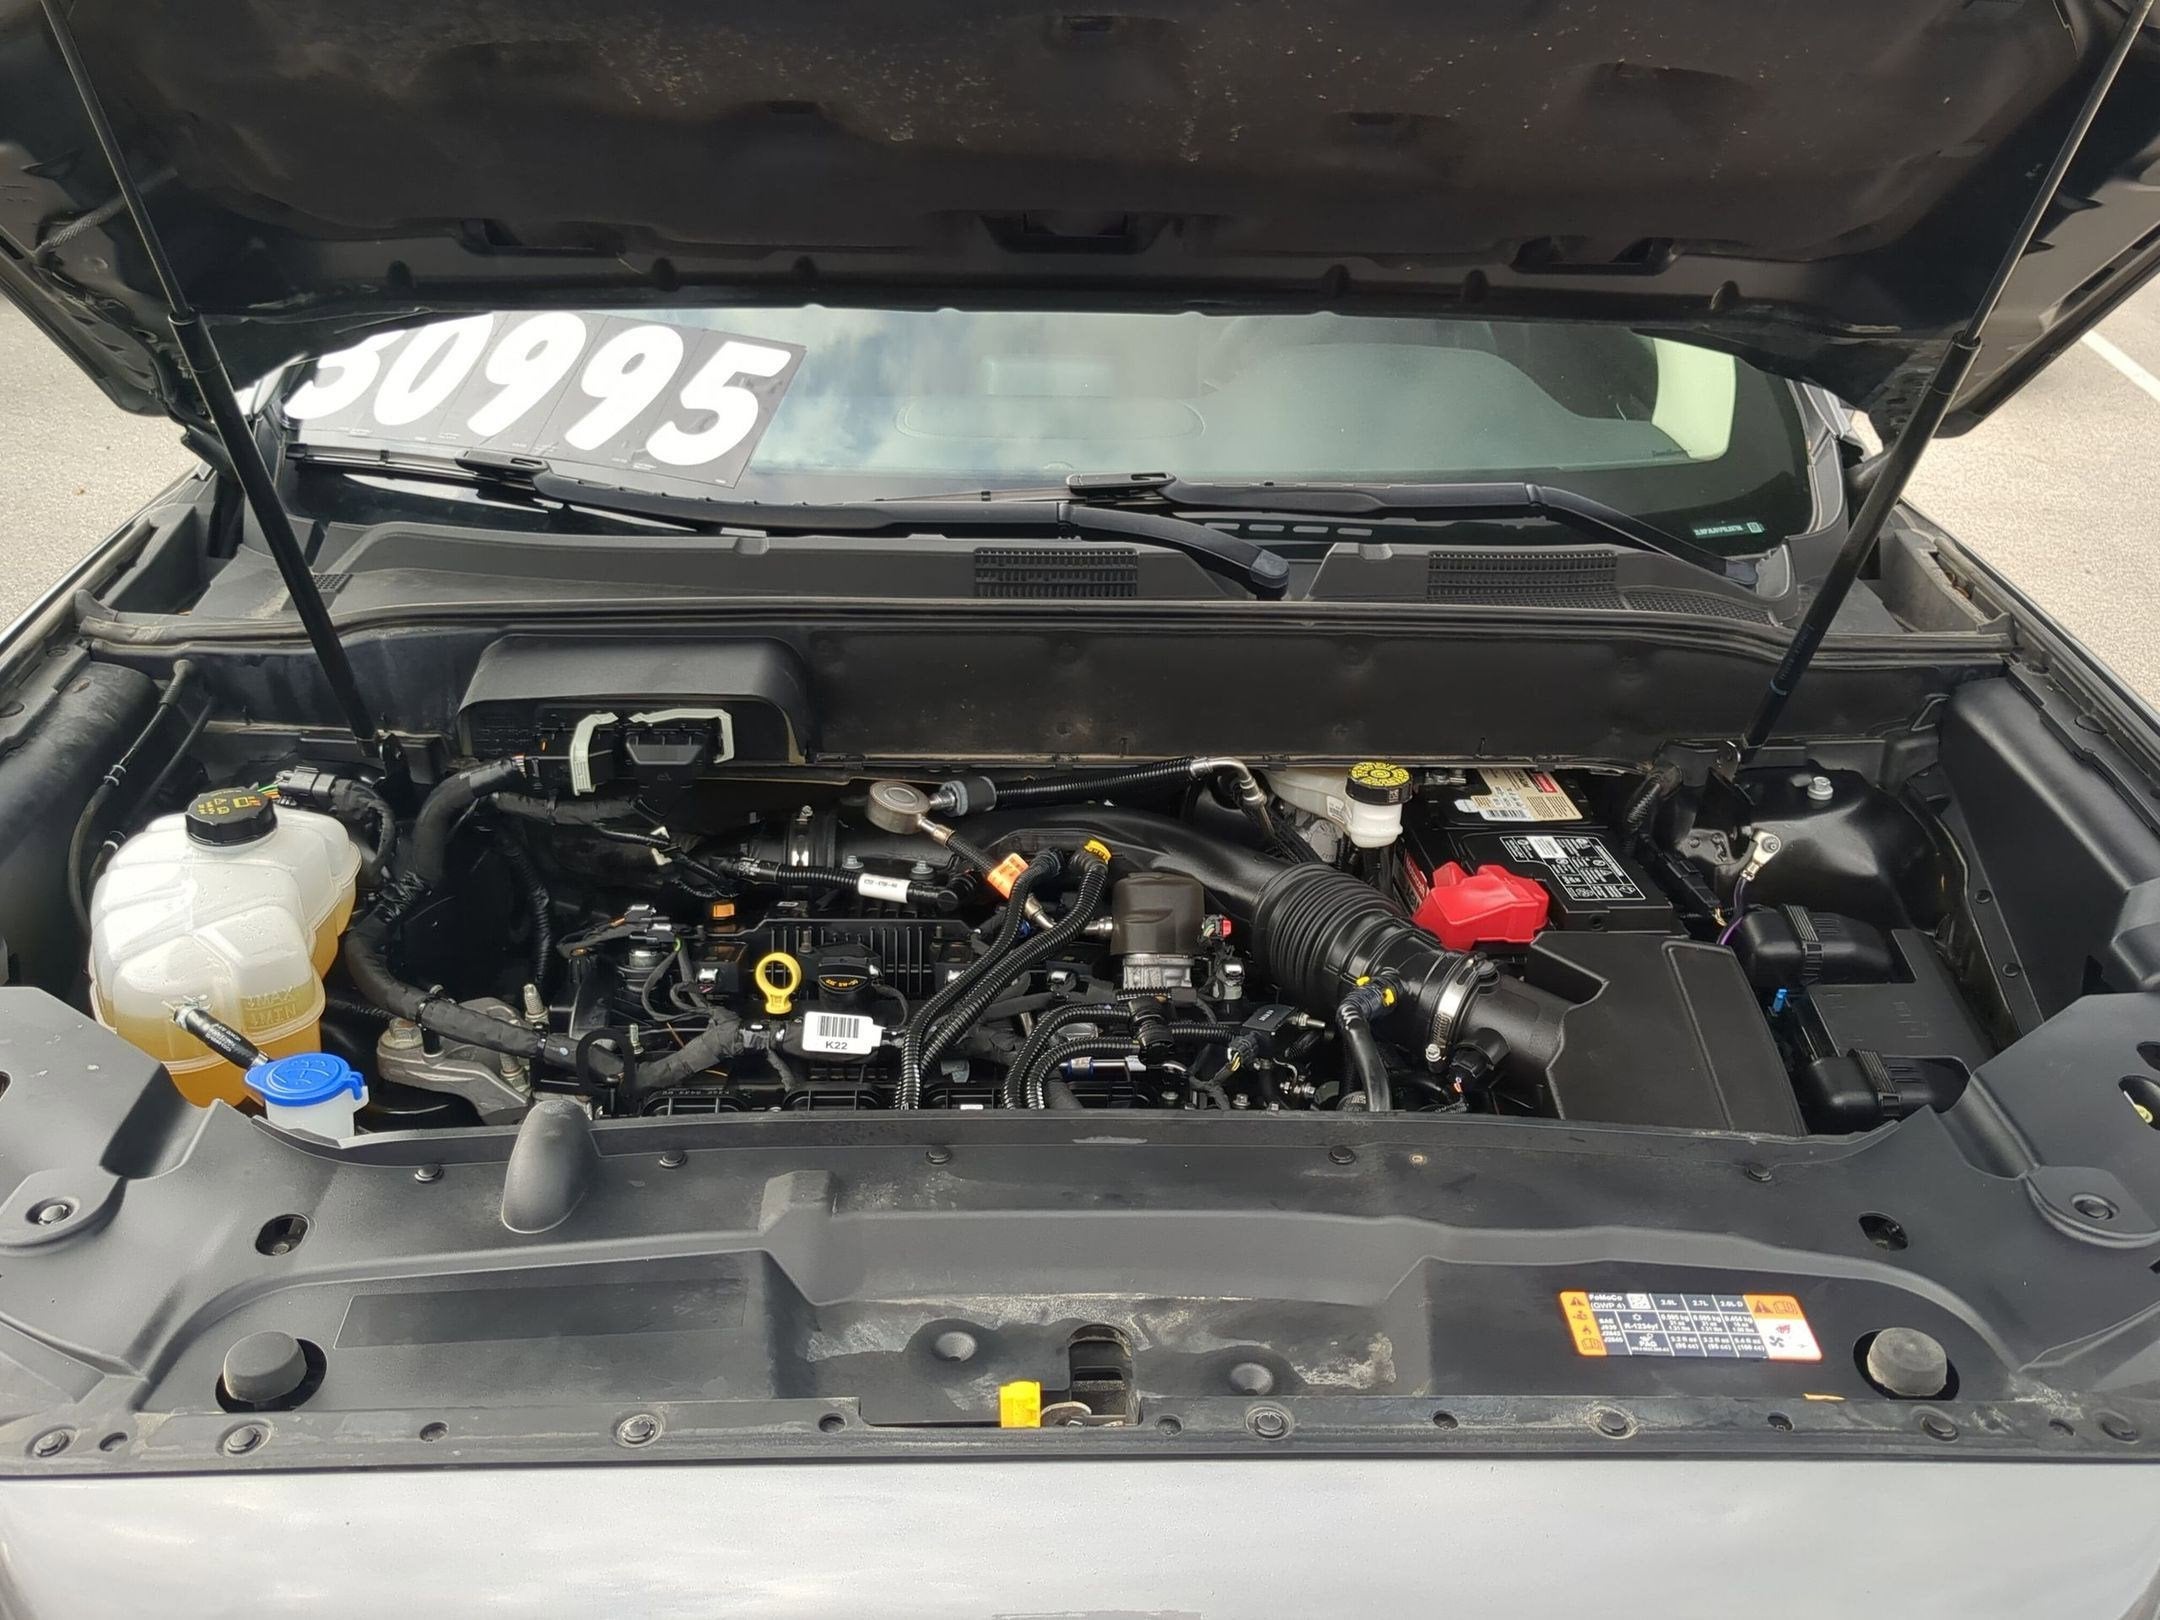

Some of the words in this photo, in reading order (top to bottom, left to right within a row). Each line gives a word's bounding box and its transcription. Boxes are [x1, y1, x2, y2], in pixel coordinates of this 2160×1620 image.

[284, 311, 792, 466] 30995
[825, 1040, 848, 1050] K22
[1588, 1293, 1623, 1302] FoMoCo
[1692, 1299, 1709, 1307] 2.7L
[1624, 1322, 1659, 1331] R-1234yf
